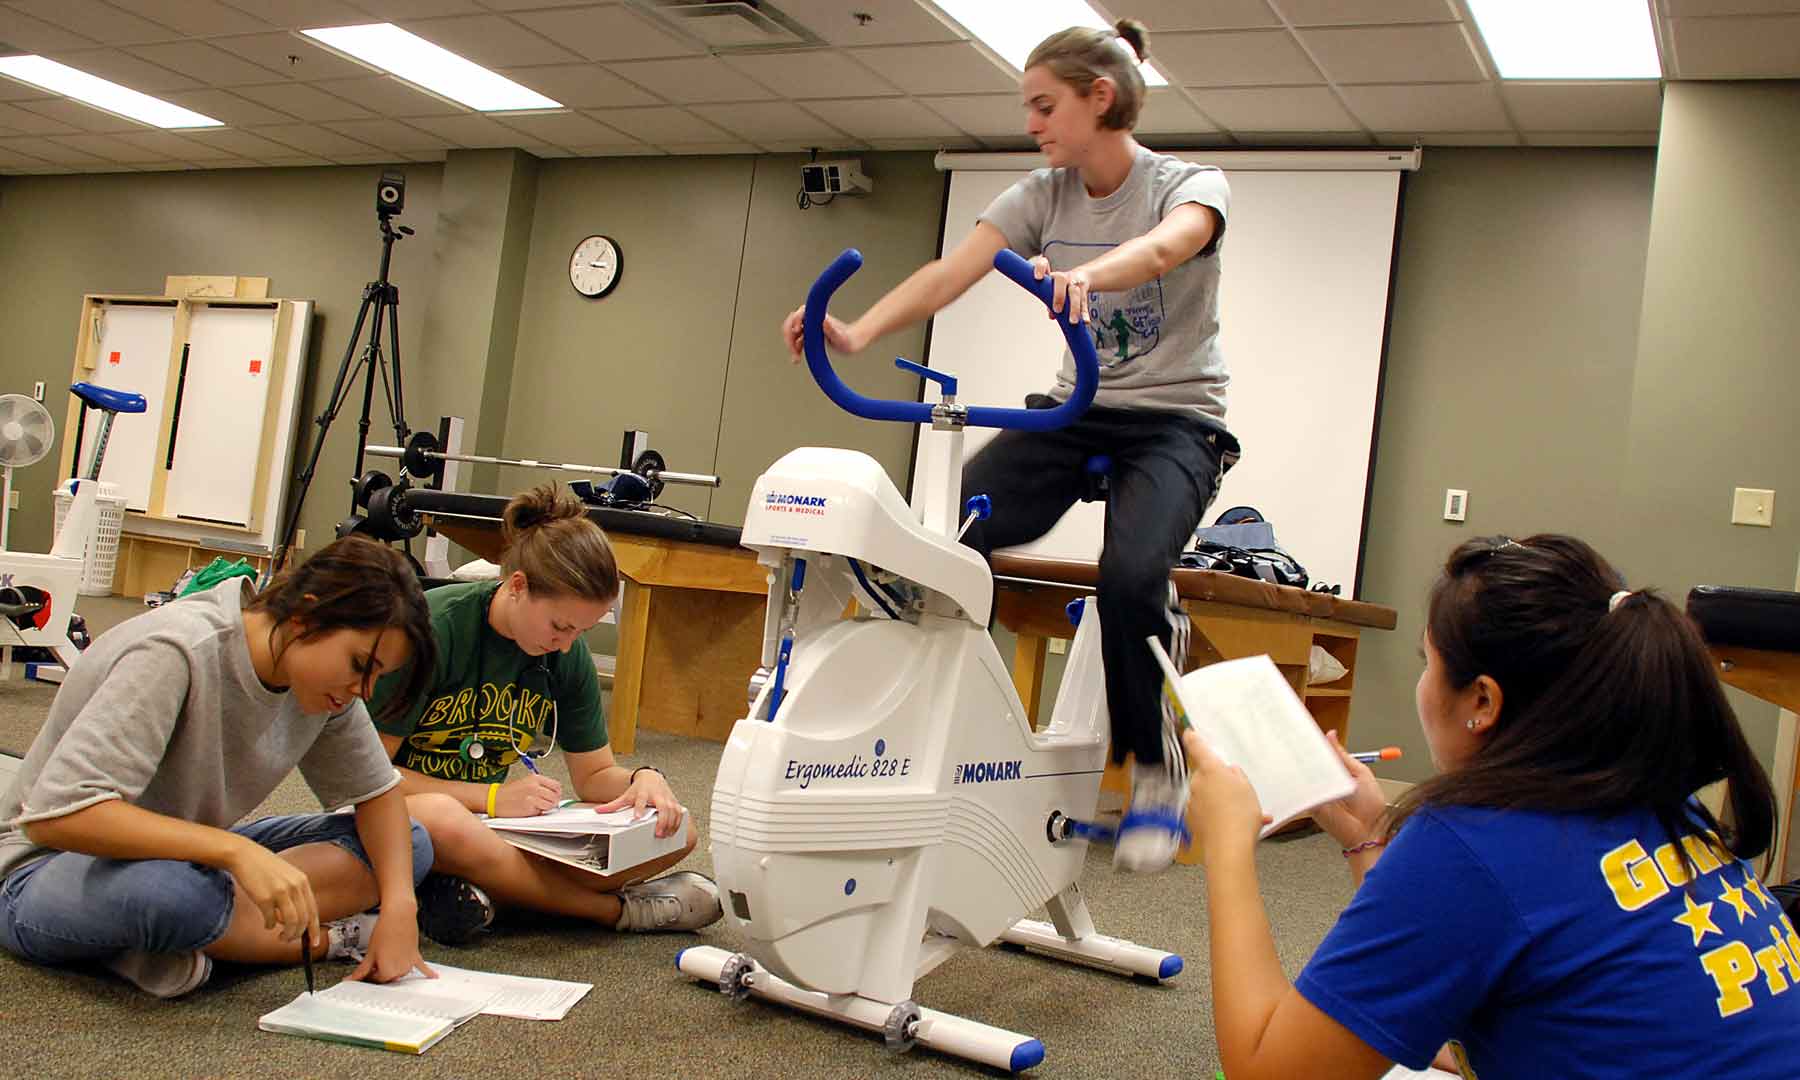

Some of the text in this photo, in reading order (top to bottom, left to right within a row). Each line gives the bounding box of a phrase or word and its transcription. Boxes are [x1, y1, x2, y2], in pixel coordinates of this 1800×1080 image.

[777, 494, 827, 507] MONARK
[795, 507, 825, 516] MEDICAL
[785, 755, 911, 789] Ergomedic 828 E
[962, 760, 1023, 784] MONARK
